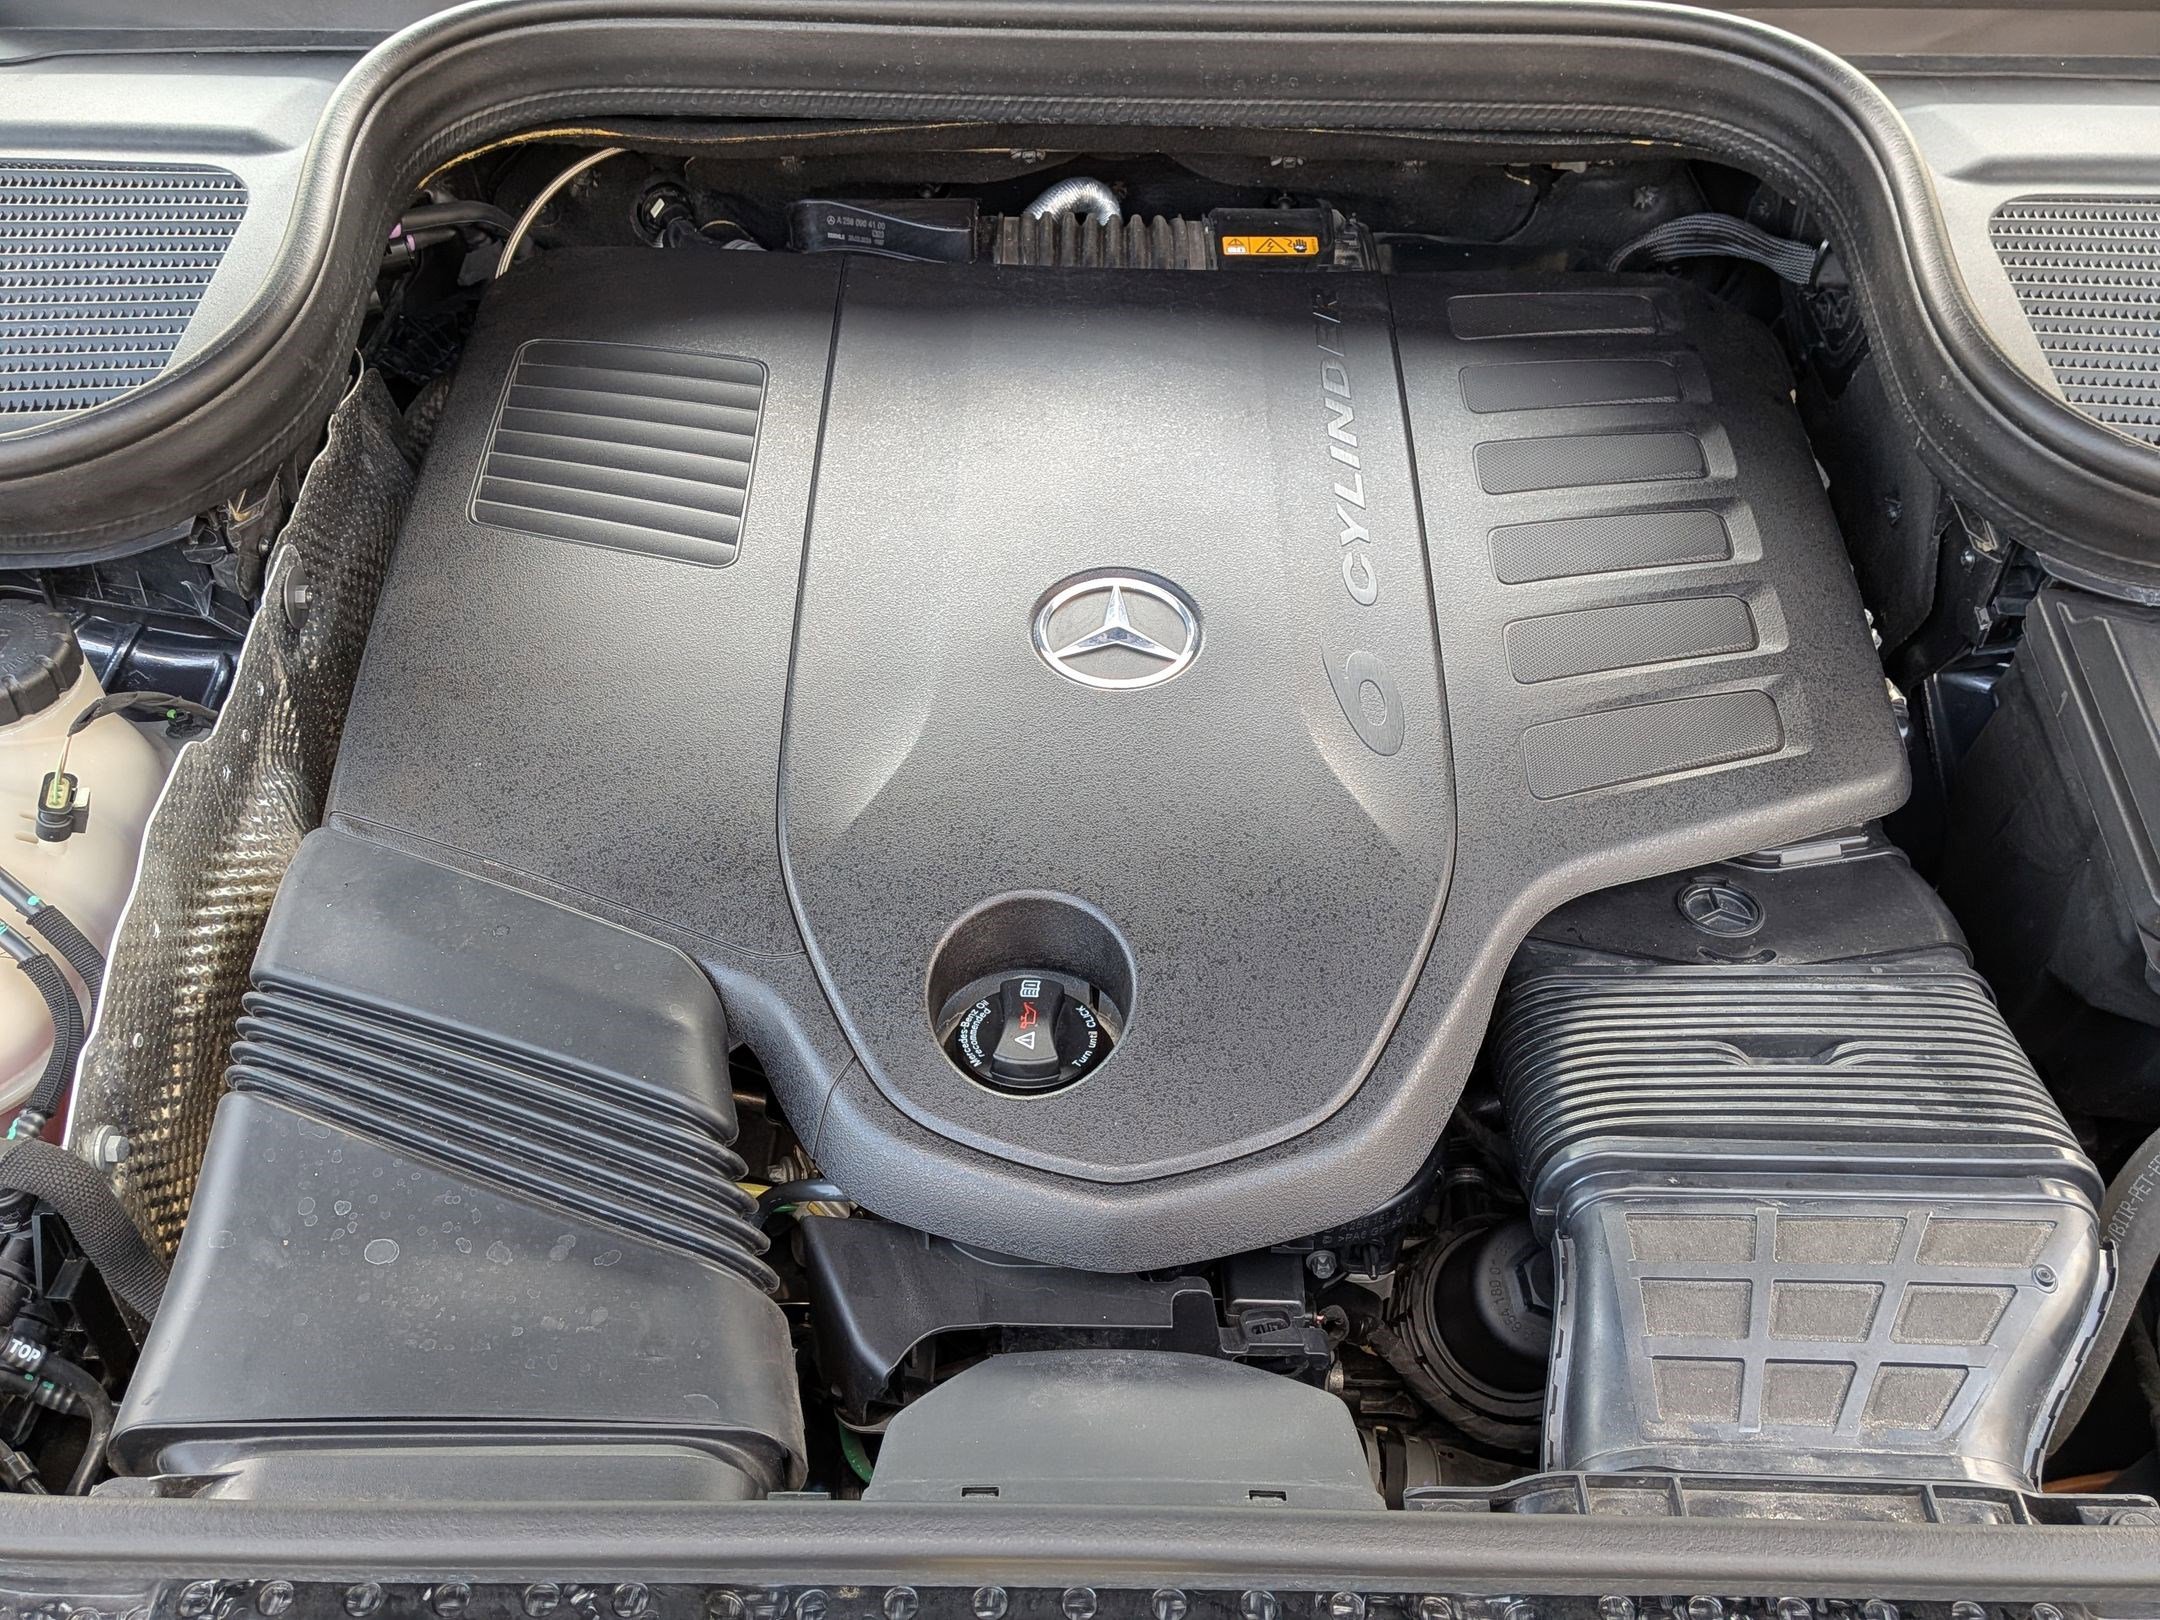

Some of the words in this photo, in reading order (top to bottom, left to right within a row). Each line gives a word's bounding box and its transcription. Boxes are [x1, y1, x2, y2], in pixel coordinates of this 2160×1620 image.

[1312, 291, 1379, 607] CYLINDER
[1321, 630, 1405, 757] 6
[960, 1009, 983, 1068] Mercedes-Benz
[976, 999, 990, 1010] Oil
[969, 1008, 993, 1058] recommended
[1074, 1006, 1096, 1029] CLICK
[1072, 1049, 1093, 1068] Turn
[1087, 1030, 1098, 1049] until
[9, 1337, 43, 1363] TOP
